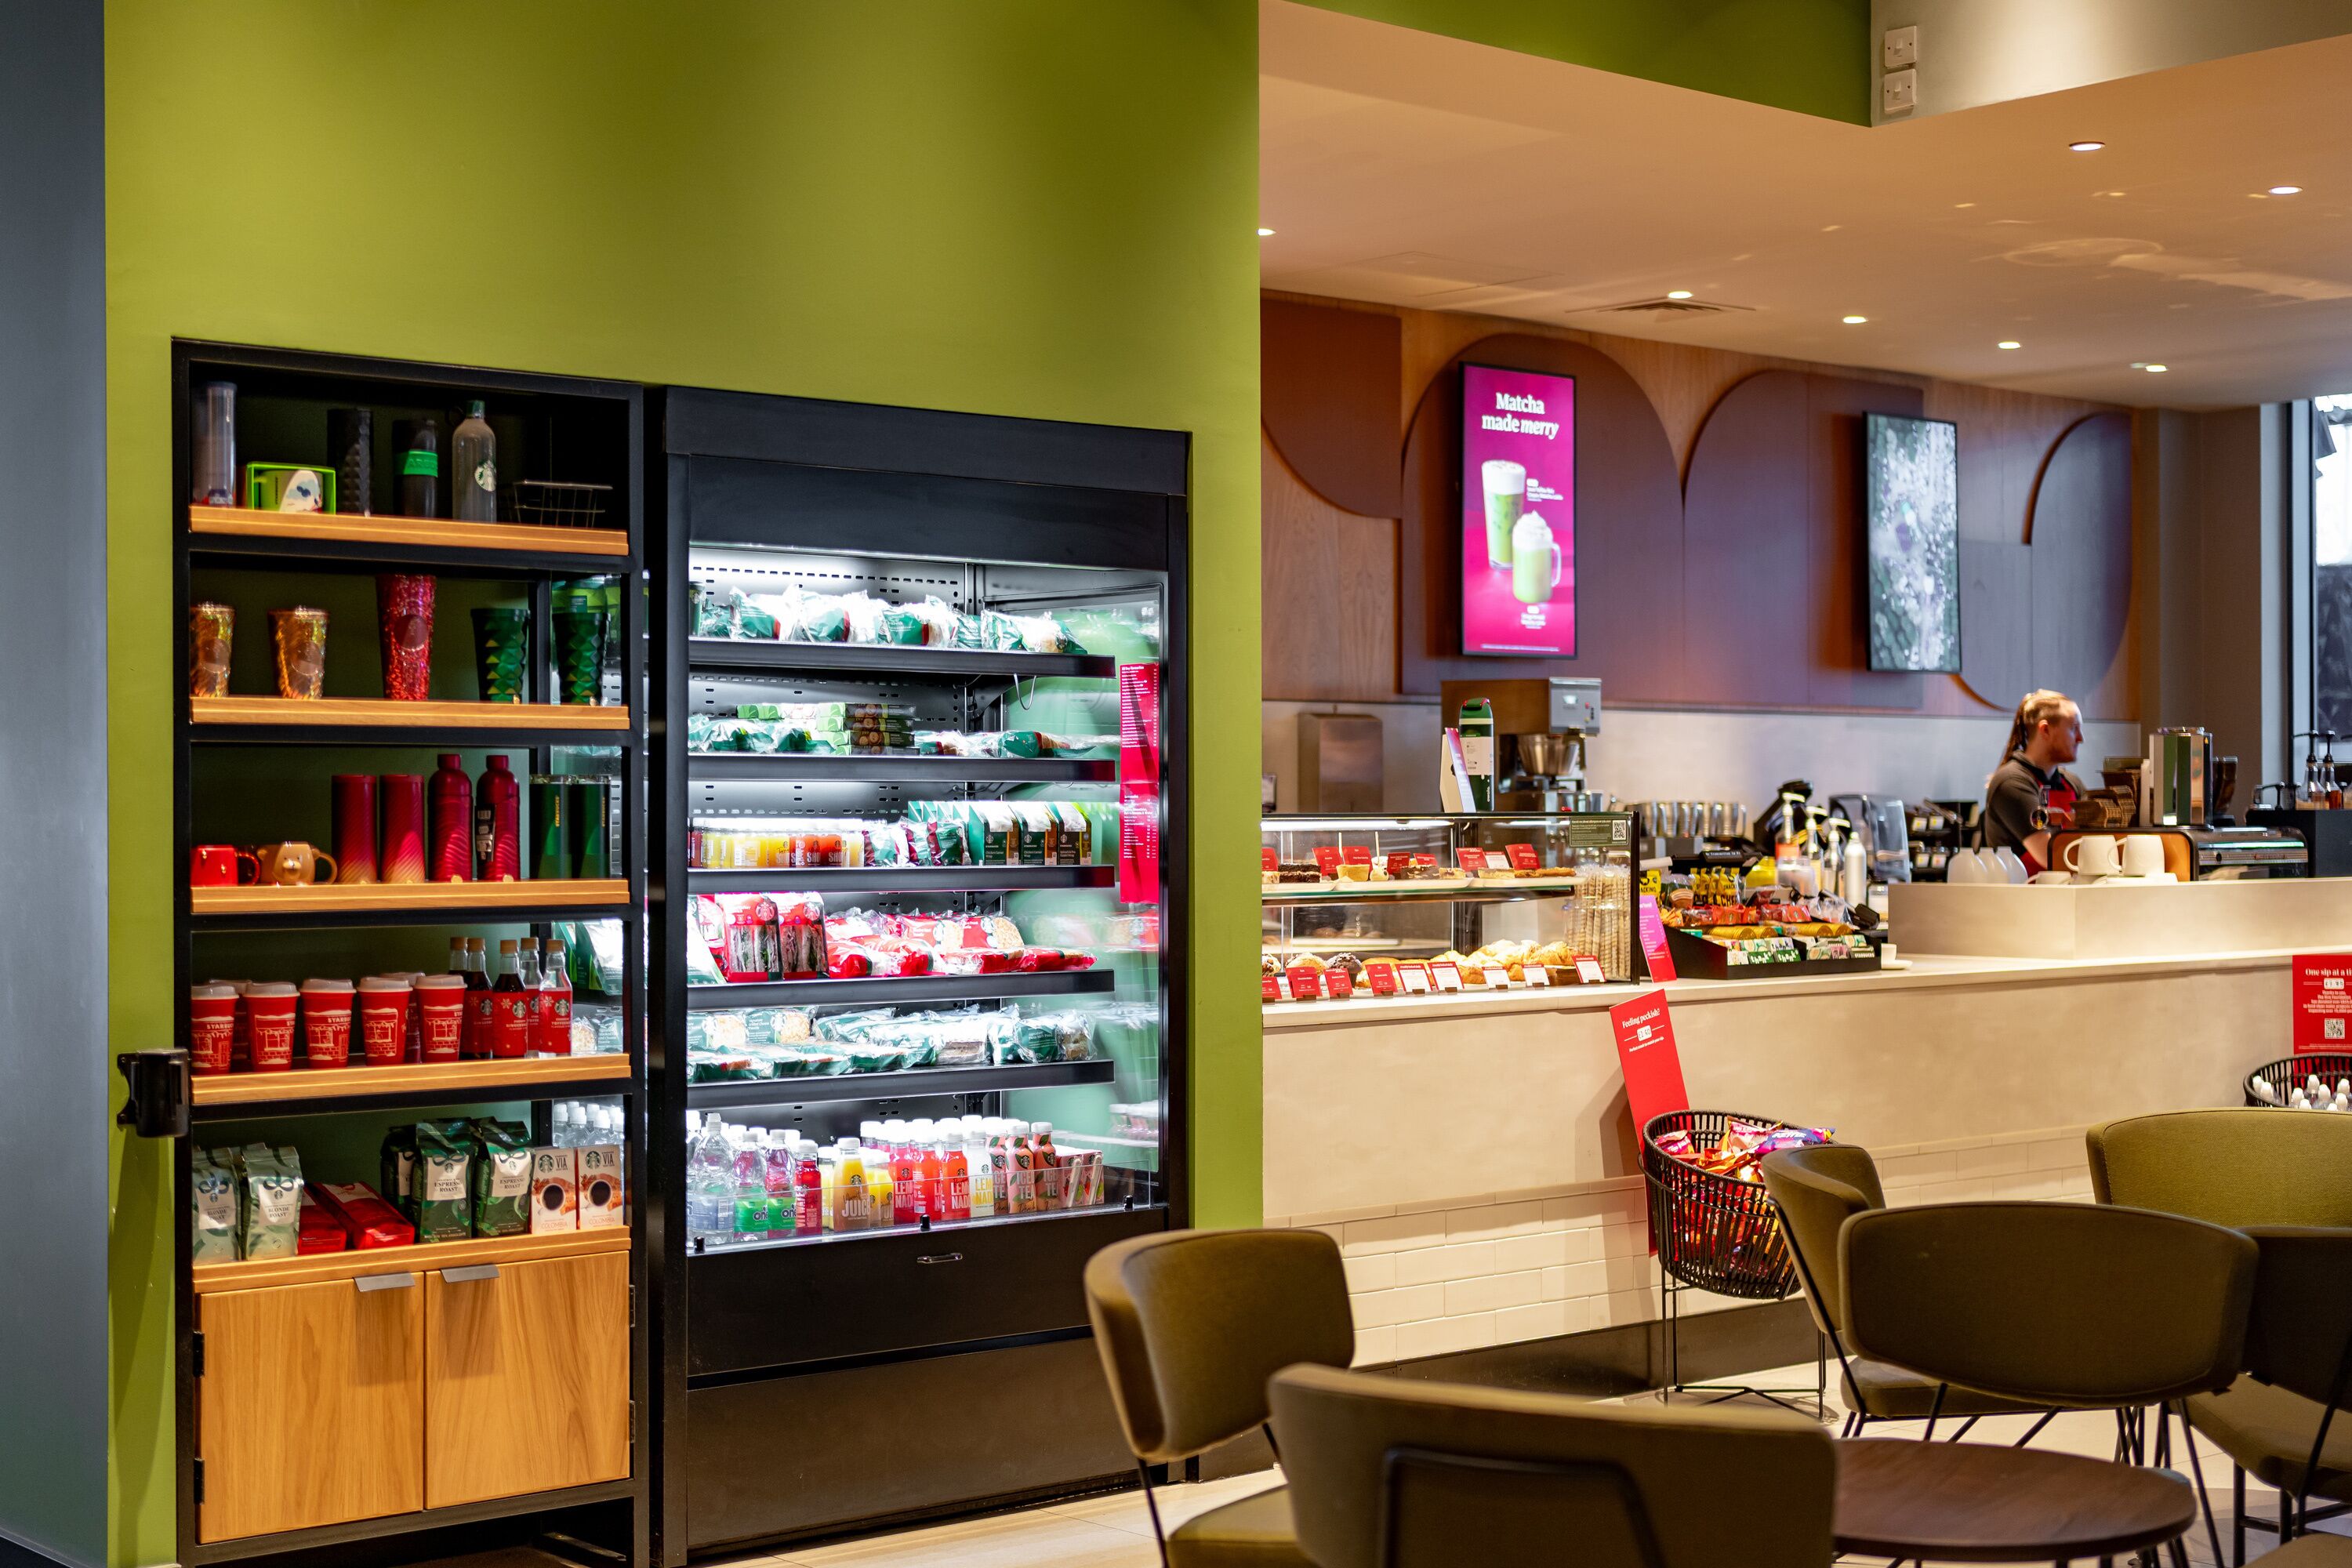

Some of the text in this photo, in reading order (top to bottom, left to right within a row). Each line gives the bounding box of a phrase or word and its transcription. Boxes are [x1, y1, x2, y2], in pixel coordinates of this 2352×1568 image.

[1496, 392, 1545, 414] Matcha
[1482, 413, 1559, 440] made merry
[807, 852, 821, 862] SHO
[828, 851, 842, 862] SHO
[2305, 967, 2320, 976] One
[2321, 967, 2332, 977] sip
[1622, 1007, 1661, 1029] Feeling peckish?
[556, 1157, 568, 1168] VIA
[603, 1153, 614, 1164] VIA
